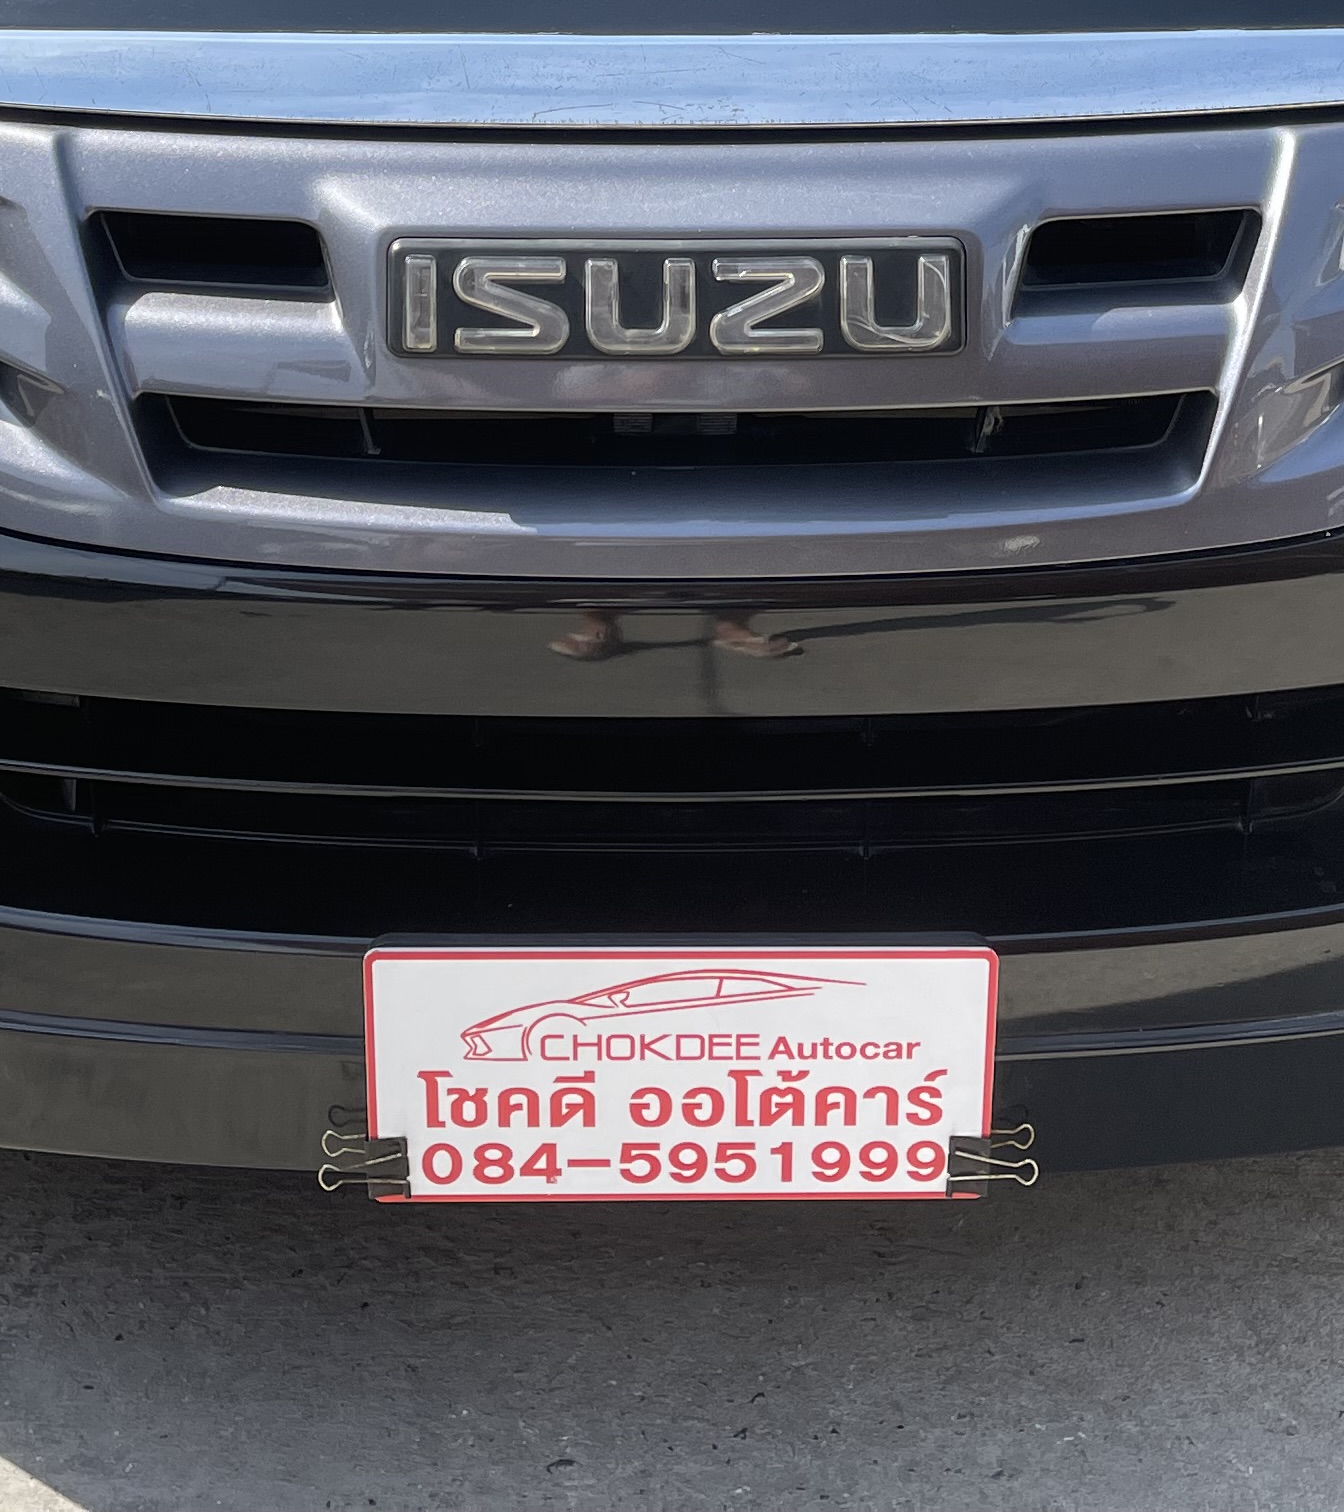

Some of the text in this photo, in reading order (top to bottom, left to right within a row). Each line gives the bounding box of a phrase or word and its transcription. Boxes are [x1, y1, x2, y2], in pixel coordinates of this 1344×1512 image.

[402, 254, 952, 355] ISUZU
[539, 1033, 921, 1061] CHOKDEE Autocar
[417, 1068, 949, 1129] โชคดี ออโต้คาร์
[421, 1140, 947, 1185] 084-5951999
